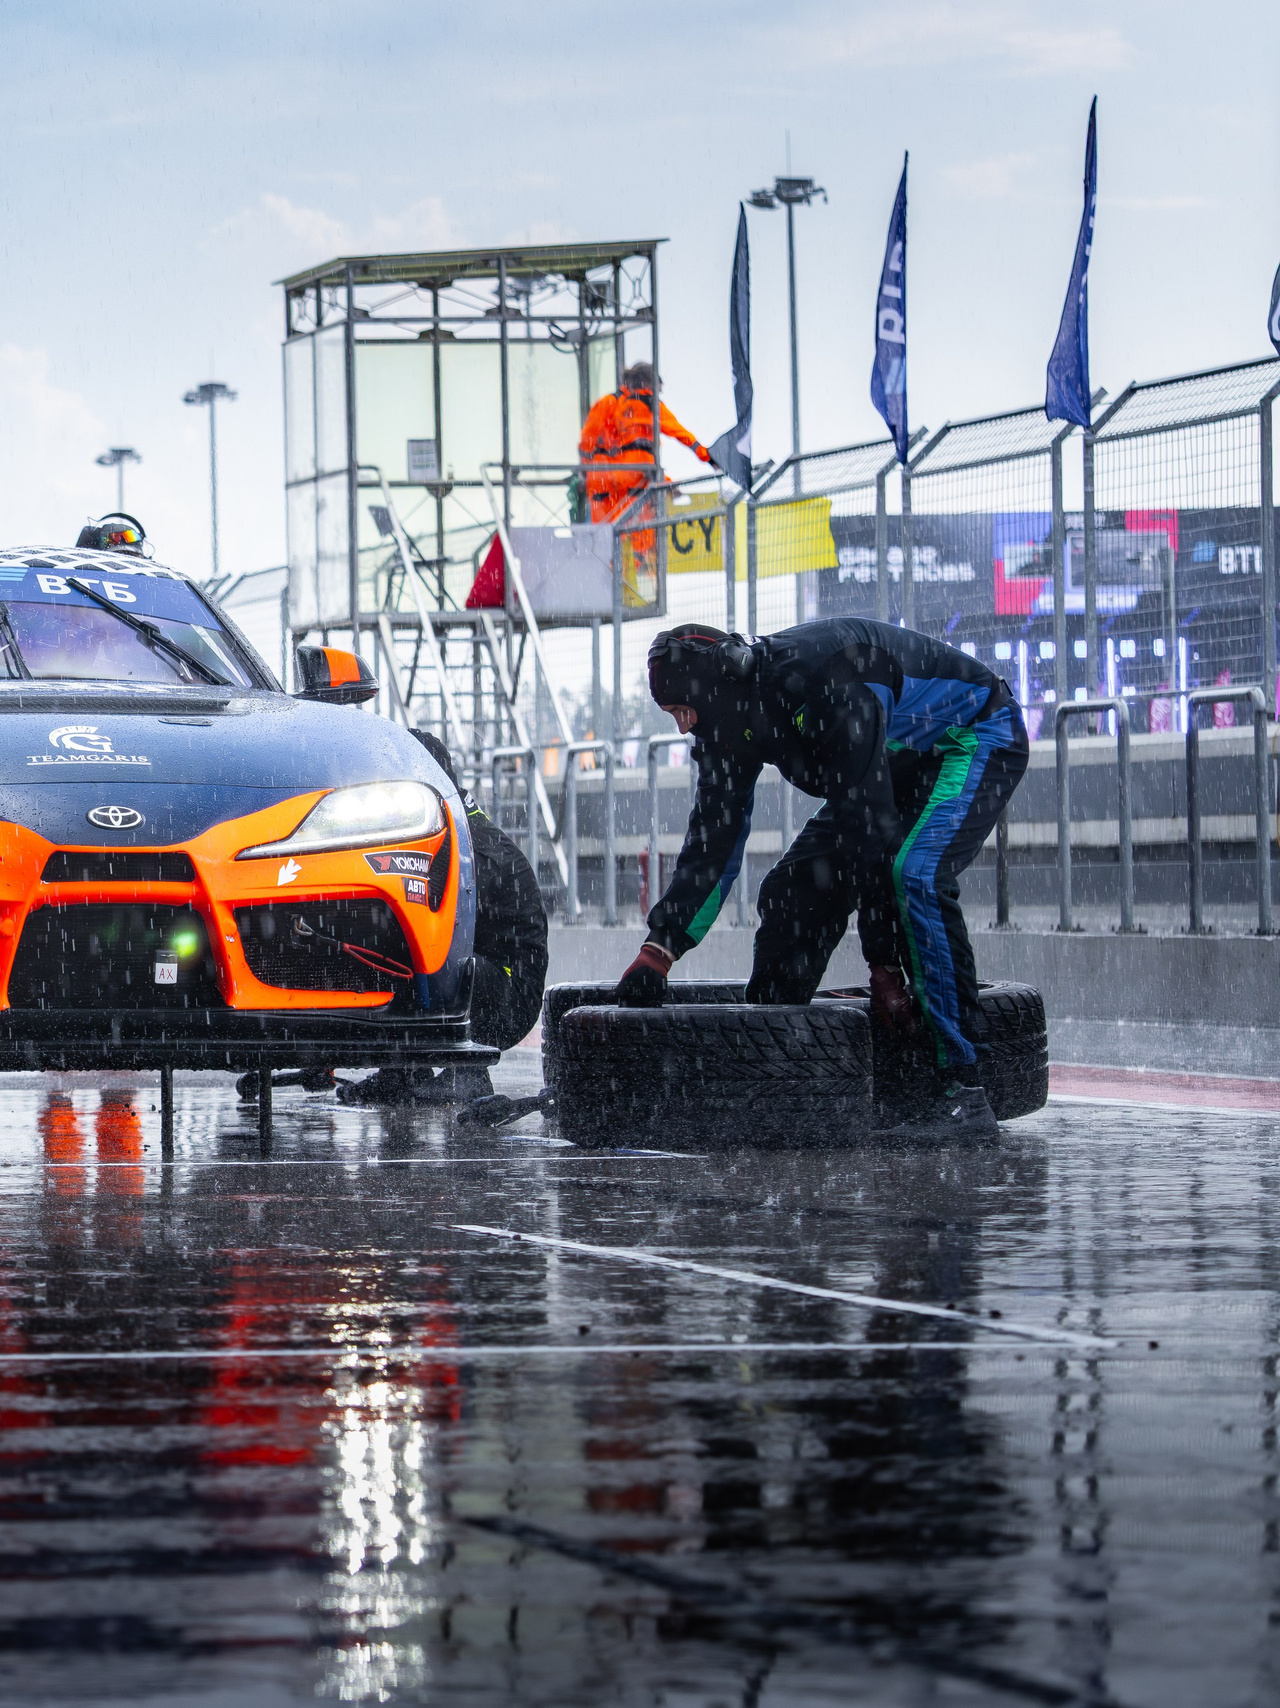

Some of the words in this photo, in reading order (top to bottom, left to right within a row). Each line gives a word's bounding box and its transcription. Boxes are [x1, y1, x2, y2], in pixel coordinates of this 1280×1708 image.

[1219, 545, 1263, 574] ВТ
[26, 754, 149, 763] TEAMGARIS
[407, 879, 426, 895] АВТО
[158, 967, 174, 980] AX
